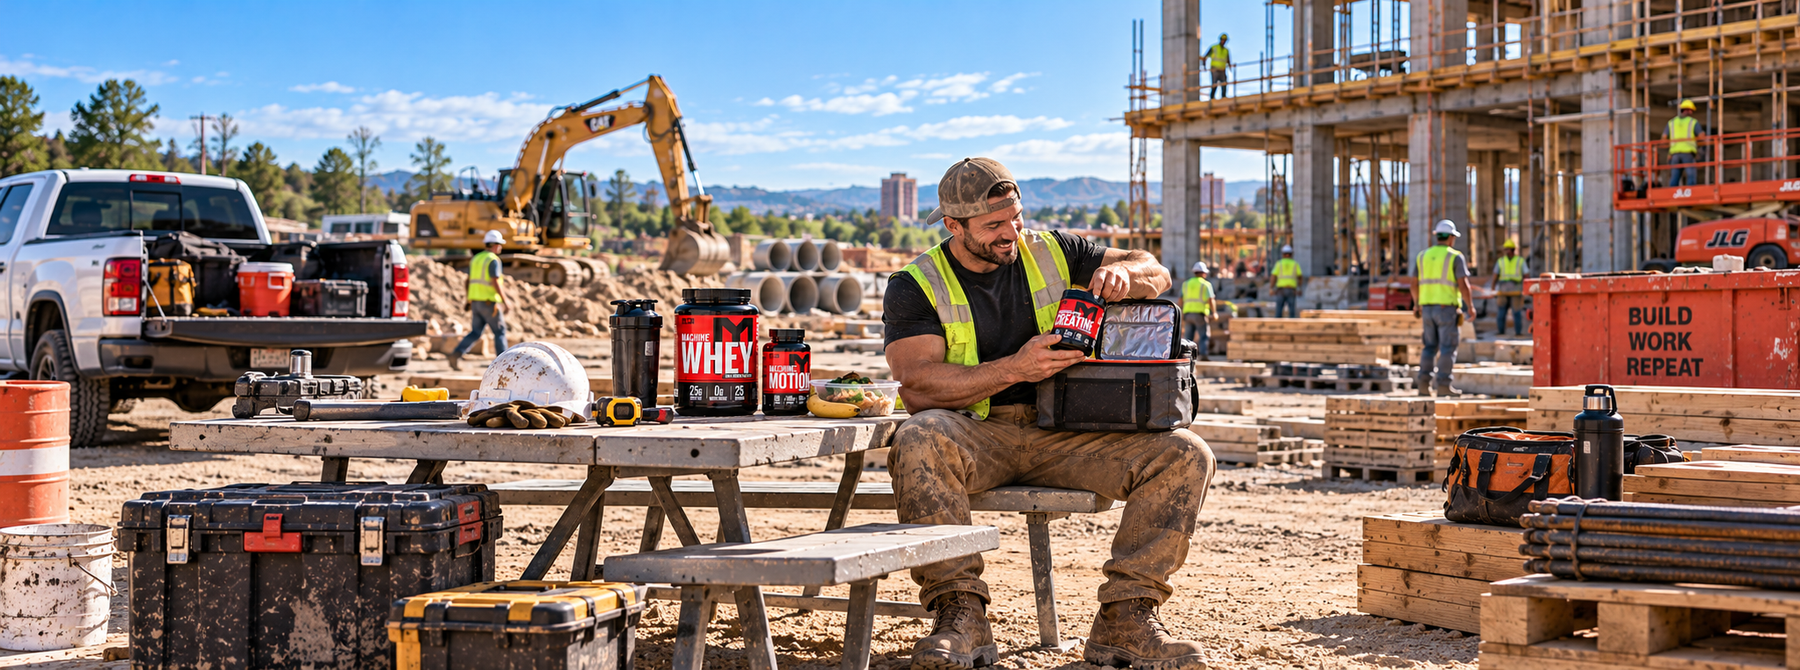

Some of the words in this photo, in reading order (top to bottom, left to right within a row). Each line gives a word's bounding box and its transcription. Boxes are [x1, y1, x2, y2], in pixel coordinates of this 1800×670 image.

[590, 115, 610, 132] CAT
[1673, 188, 1692, 199] JLG
[1779, 181, 1800, 192] JLG
[1704, 229, 1750, 249] JLG
[1628, 306, 1693, 326] BUILD
[1628, 331, 1693, 351] WORK
[681, 341, 754, 375] WHEY
[1626, 357, 1704, 377] REPEAT
[734, 384, 745, 396] 25
[769, 372, 810, 390] MOTION
